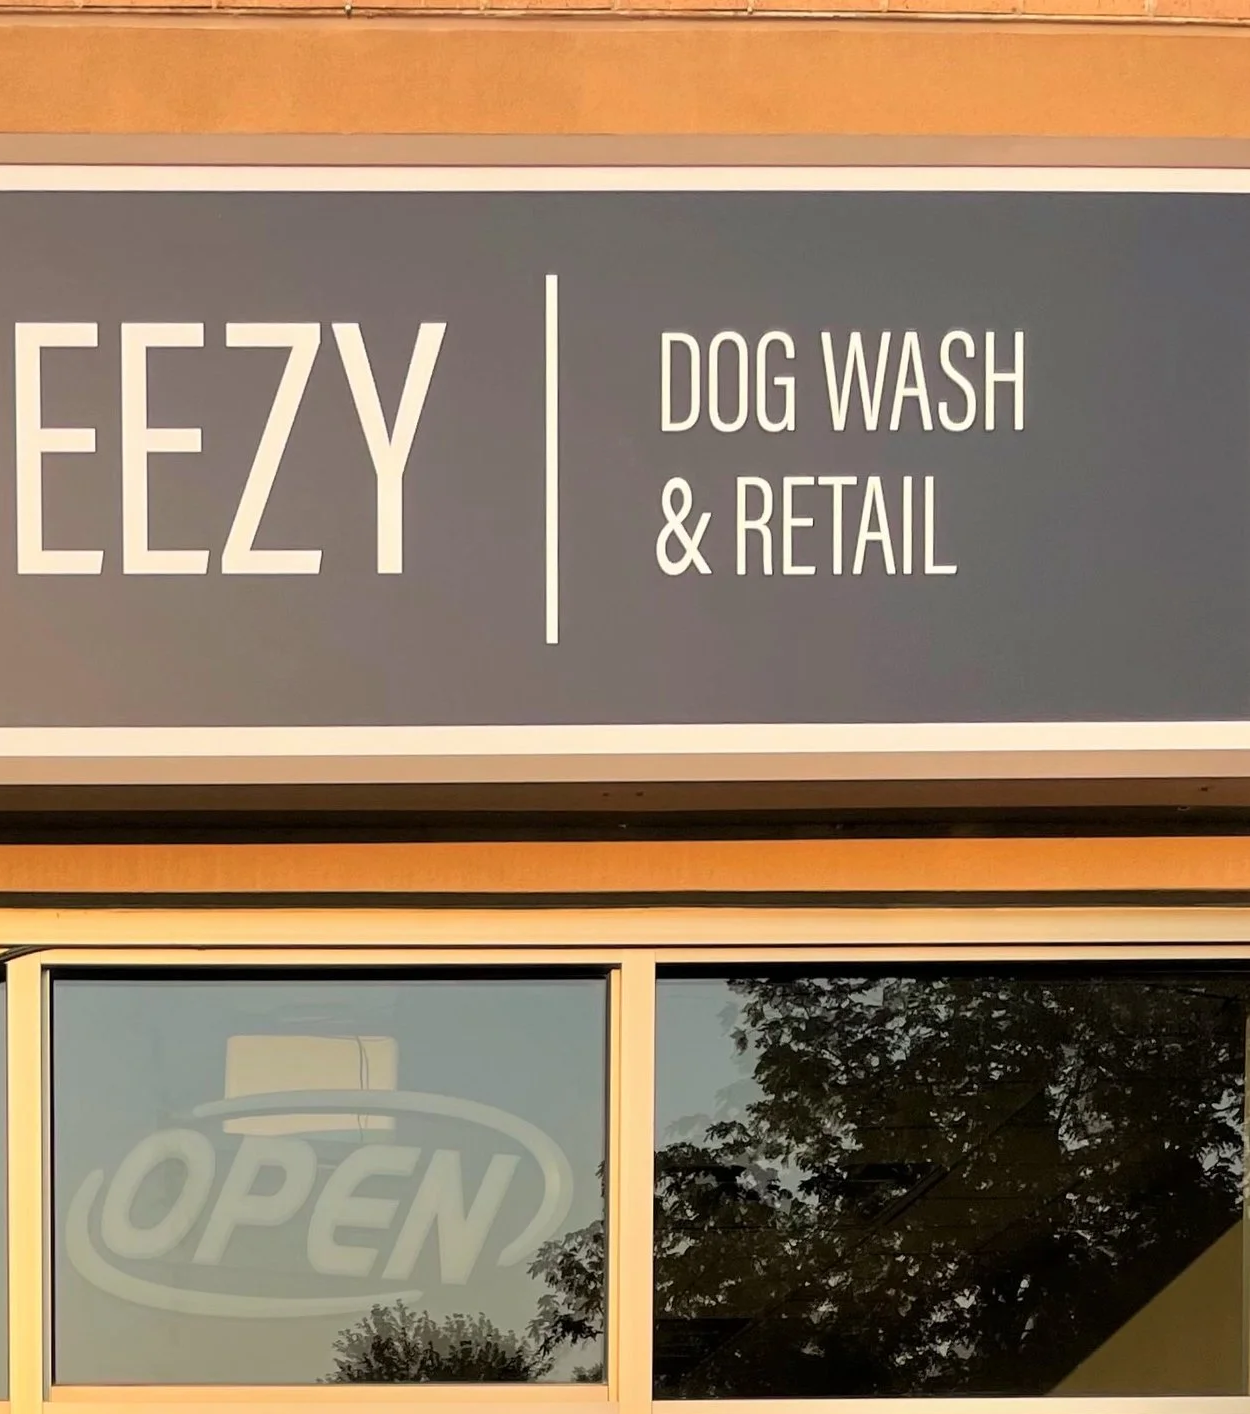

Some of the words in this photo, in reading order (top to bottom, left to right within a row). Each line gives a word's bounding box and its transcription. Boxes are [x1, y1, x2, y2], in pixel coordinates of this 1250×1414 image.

[661, 330, 795, 433] DOG
[821, 330, 1025, 432] WASH
[655, 477, 712, 575] &
[736, 475, 958, 575] RETAIL
[101, 1127, 522, 1285] OPEN
